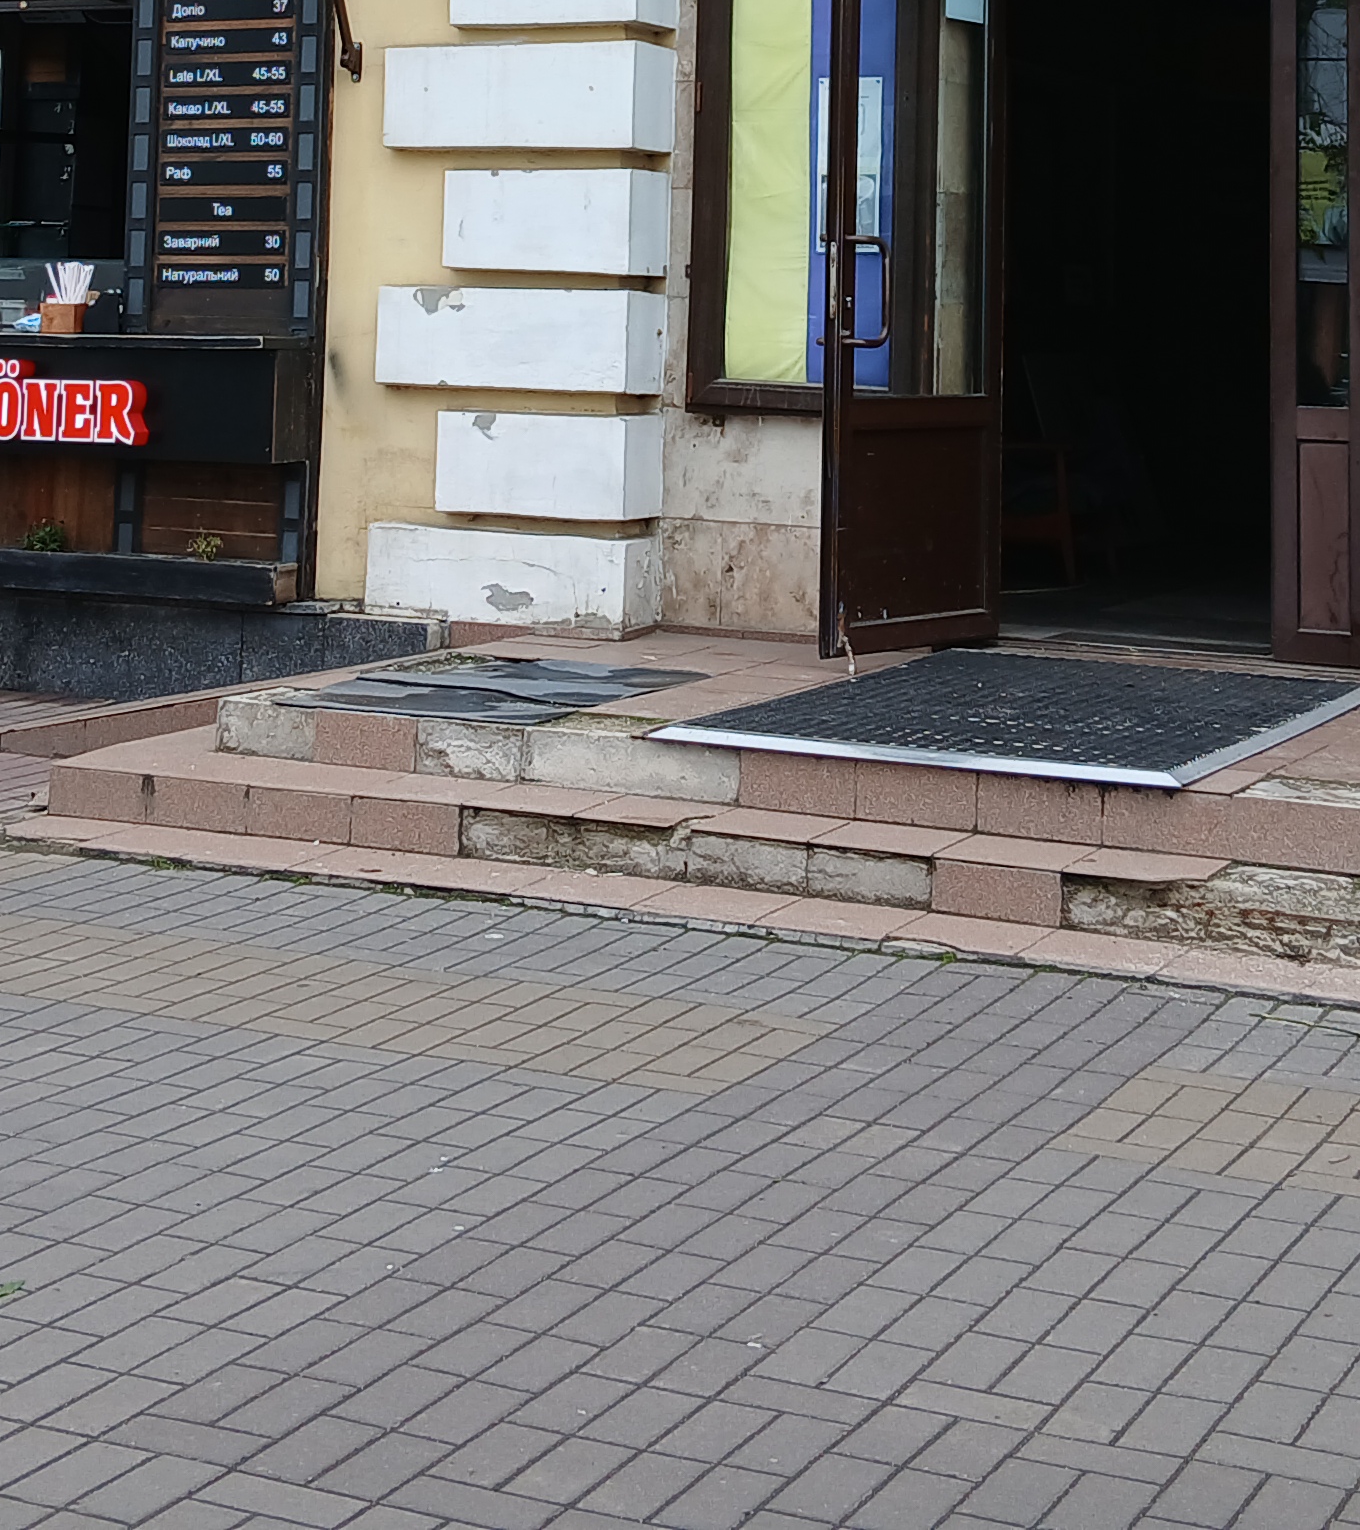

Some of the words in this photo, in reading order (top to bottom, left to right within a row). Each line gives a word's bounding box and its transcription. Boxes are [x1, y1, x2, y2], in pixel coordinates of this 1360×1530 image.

[172, 3, 205, 19] Допіо
[273, 0, 288, 12] 37
[170, 35, 226, 50] Капучино
[271, 32, 287, 45] 43
[169, 69, 194, 82] Late
[197, 67, 223, 81] L/XL
[252, 67, 286, 80] 45-55
[168, 102, 202, 116] Какао
[204, 101, 231, 115] L/XL
[251, 100, 285, 113] 45-55
[166, 134, 211, 148] Шоколад
[212, 132, 234, 146] L/XL
[165, 166, 192, 181] Раф
[267, 165, 282, 178] 55
[212, 202, 233, 216] Tea
[163, 235, 220, 250] Заварний
[265, 235, 280, 248] 30
[162, 268, 239, 284] Натуральний
[264, 269, 280, 281] 50
